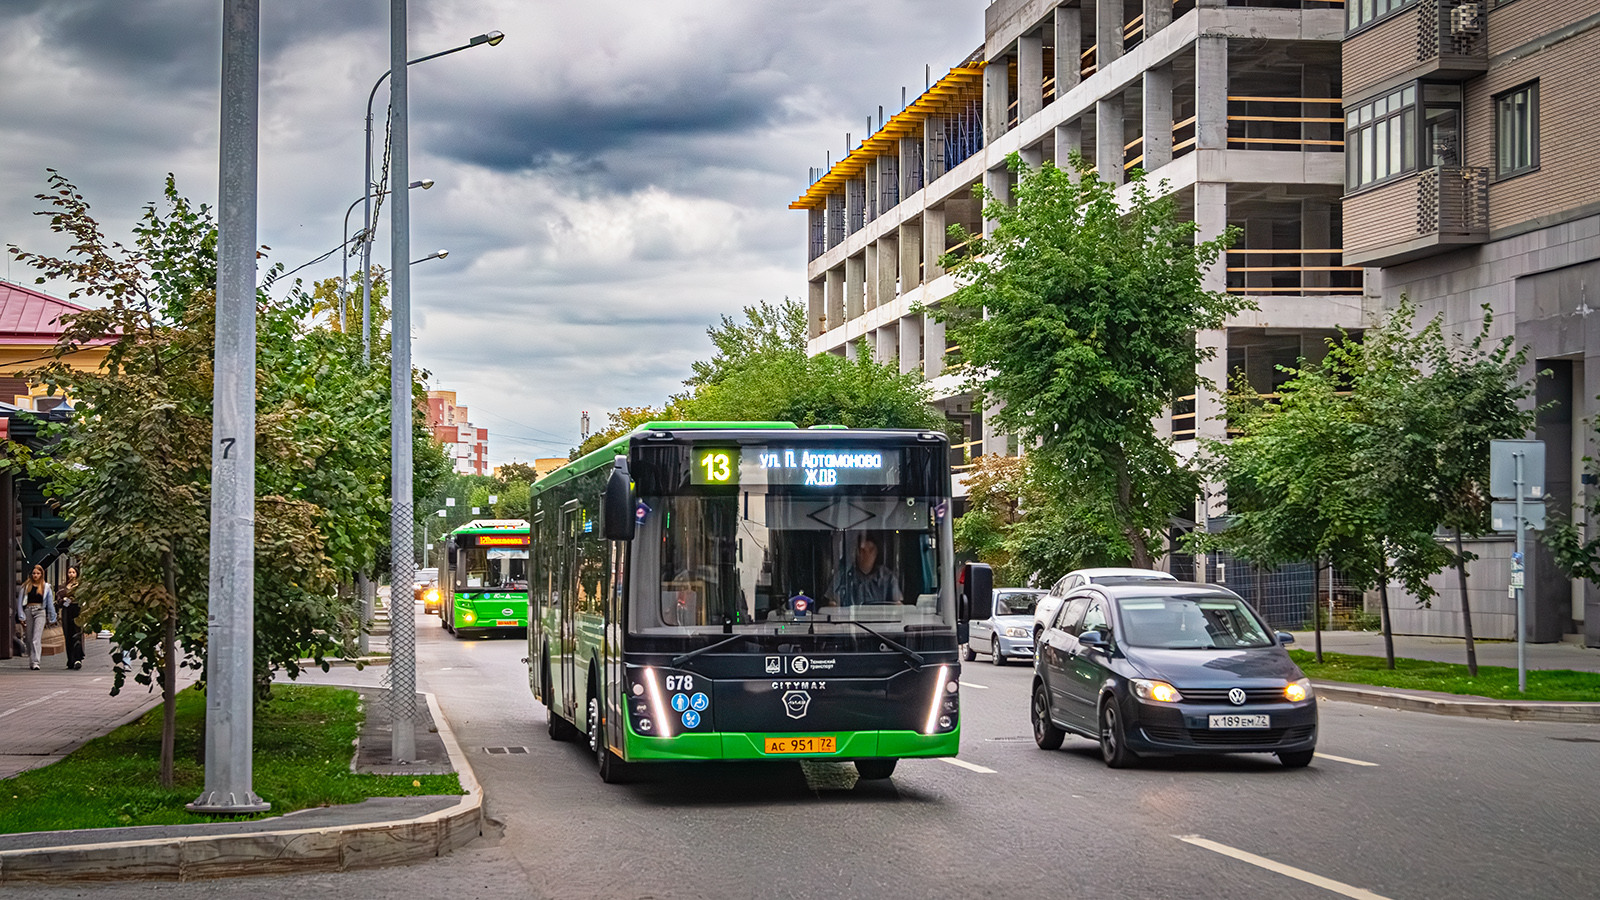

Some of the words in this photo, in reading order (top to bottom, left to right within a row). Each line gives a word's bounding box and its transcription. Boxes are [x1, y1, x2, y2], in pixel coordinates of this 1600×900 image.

[221, 438, 236, 459] 7
[701, 453, 731, 481] 13
[760, 453, 781, 469] ул.
[785, 450, 798, 468] П.
[802, 451, 882, 469] Артамонова
[805, 468, 837, 486] ЖДВ
[666, 675, 693, 690] 678
[771, 681, 826, 690] CITYMAX
[791, 739, 813, 751] 951
[820, 738, 832, 748] 72
